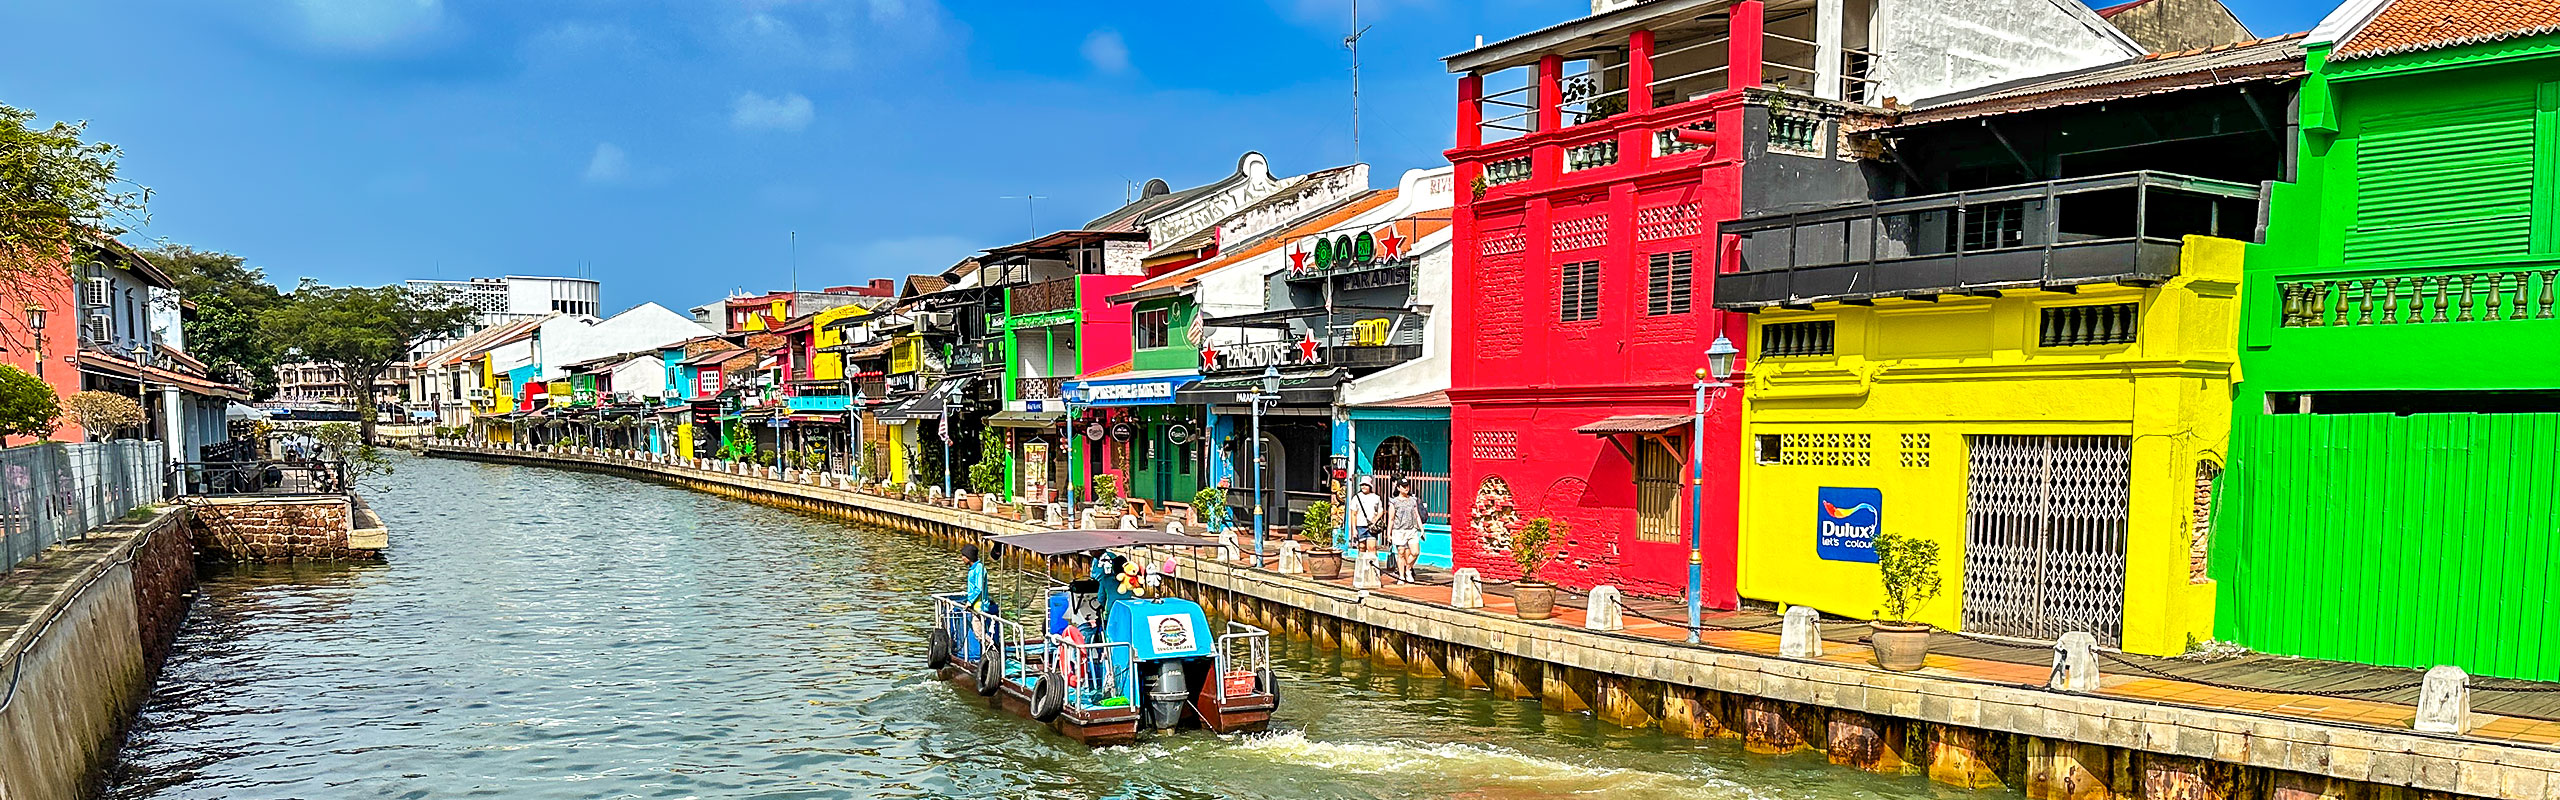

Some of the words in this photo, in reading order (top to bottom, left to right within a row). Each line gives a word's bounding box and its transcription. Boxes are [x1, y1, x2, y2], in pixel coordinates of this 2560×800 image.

[1226, 343, 1291, 368] PARADISE
[1822, 521, 1870, 538] Dulux
[1822, 537, 1839, 546] let's
